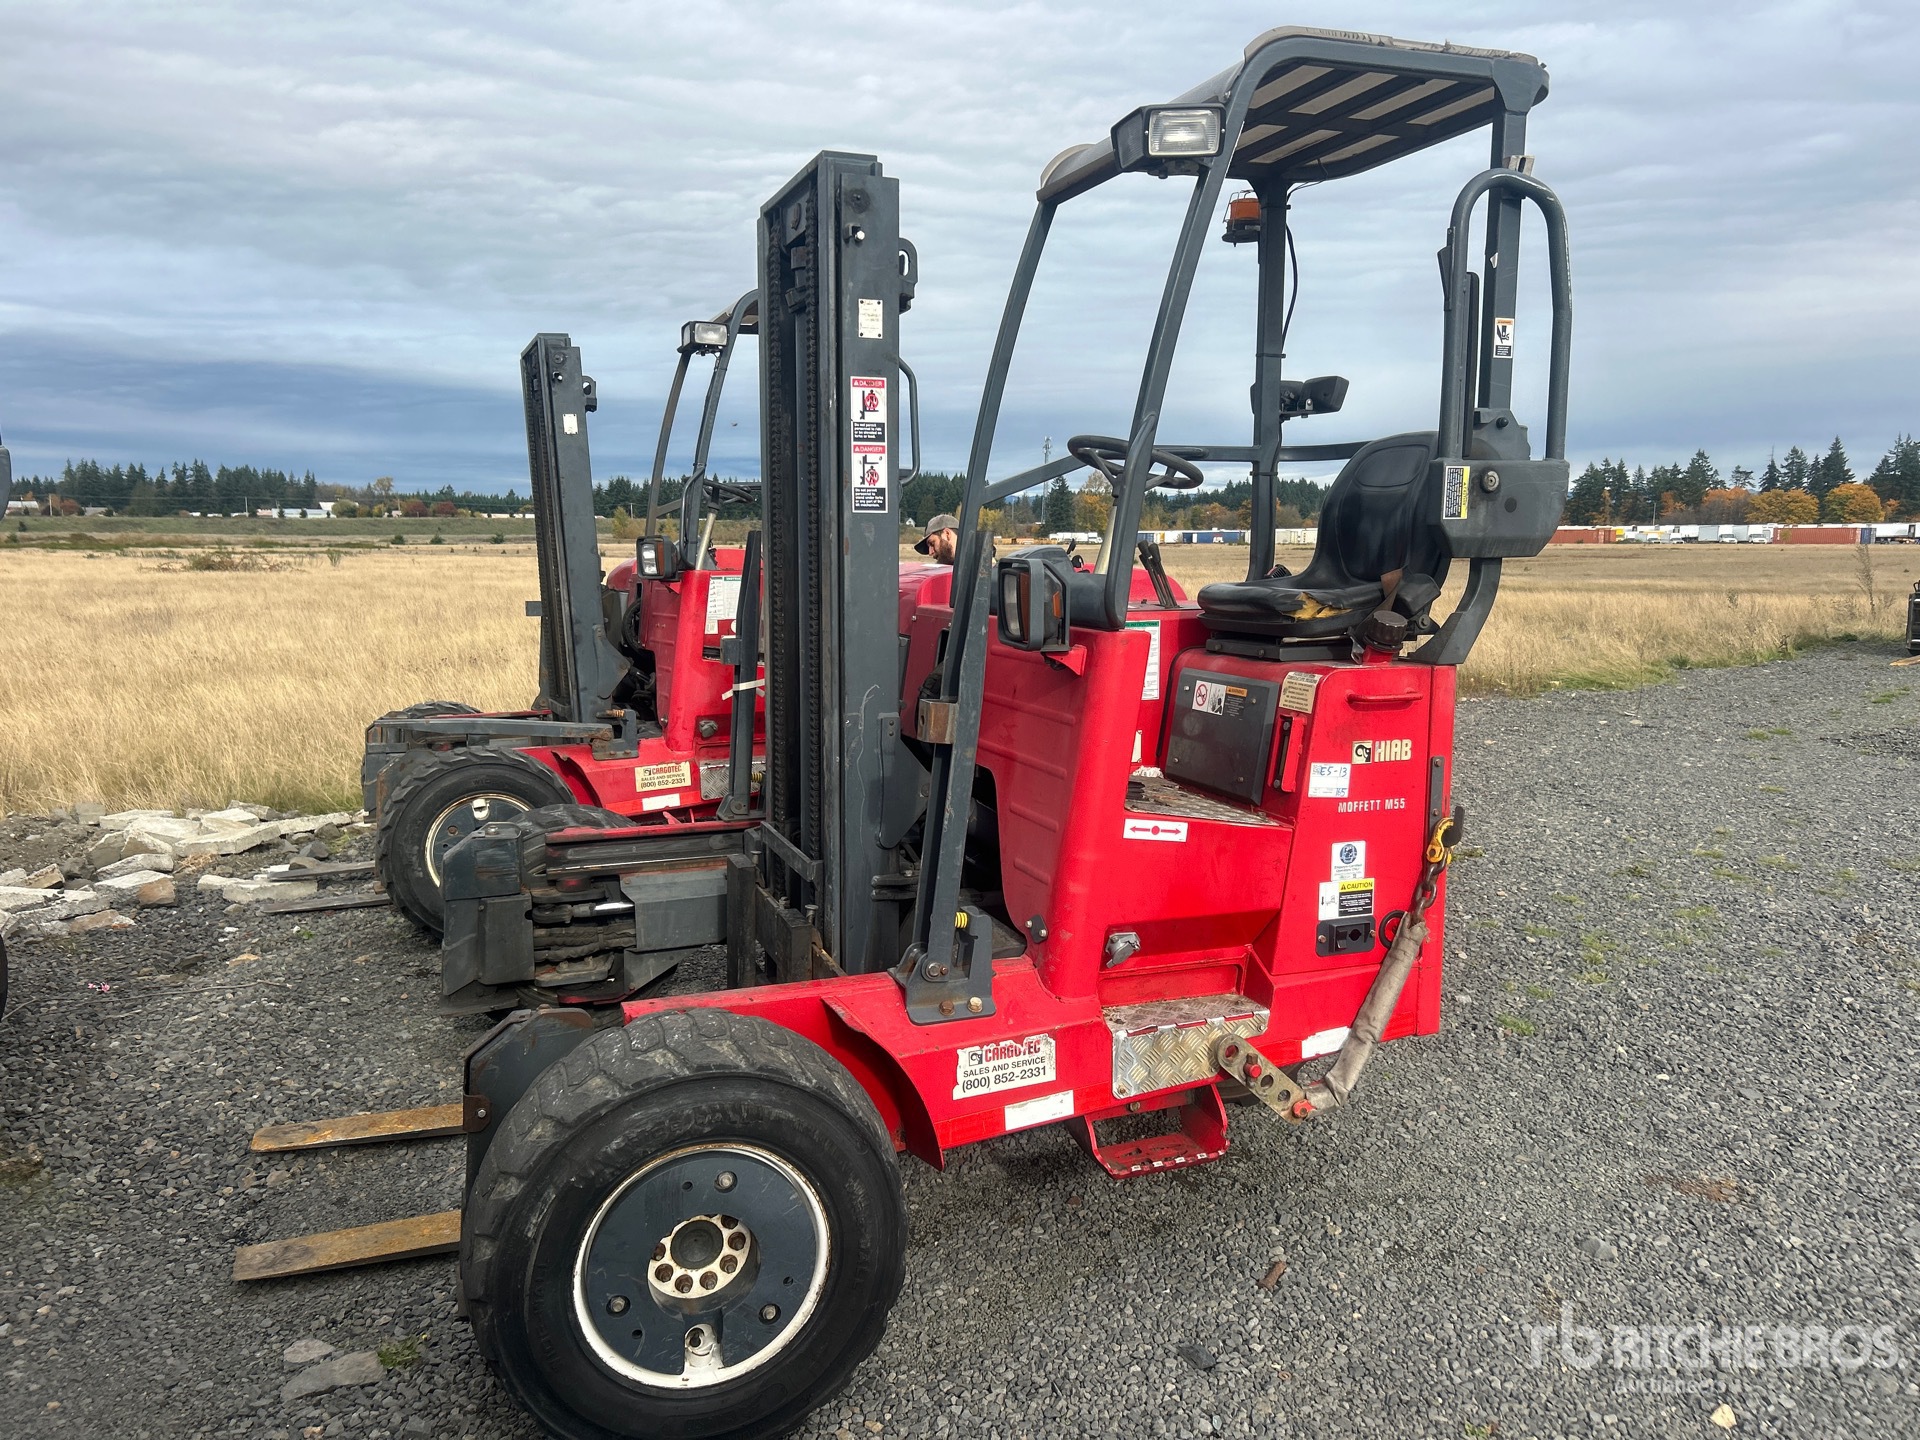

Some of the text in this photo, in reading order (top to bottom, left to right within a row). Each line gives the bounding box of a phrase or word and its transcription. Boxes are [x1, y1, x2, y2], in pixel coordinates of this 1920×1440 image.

[1374, 739, 1412, 762] HIAB
[652, 765, 682, 775] CARGOTEC
[641, 778, 686, 789] (800) 852-2331
[1338, 798, 1405, 813] MOFFETT M55
[963, 1056, 1046, 1078] SALES AND SERVICE
[962, 1066, 1046, 1093] (800) 852-2331
